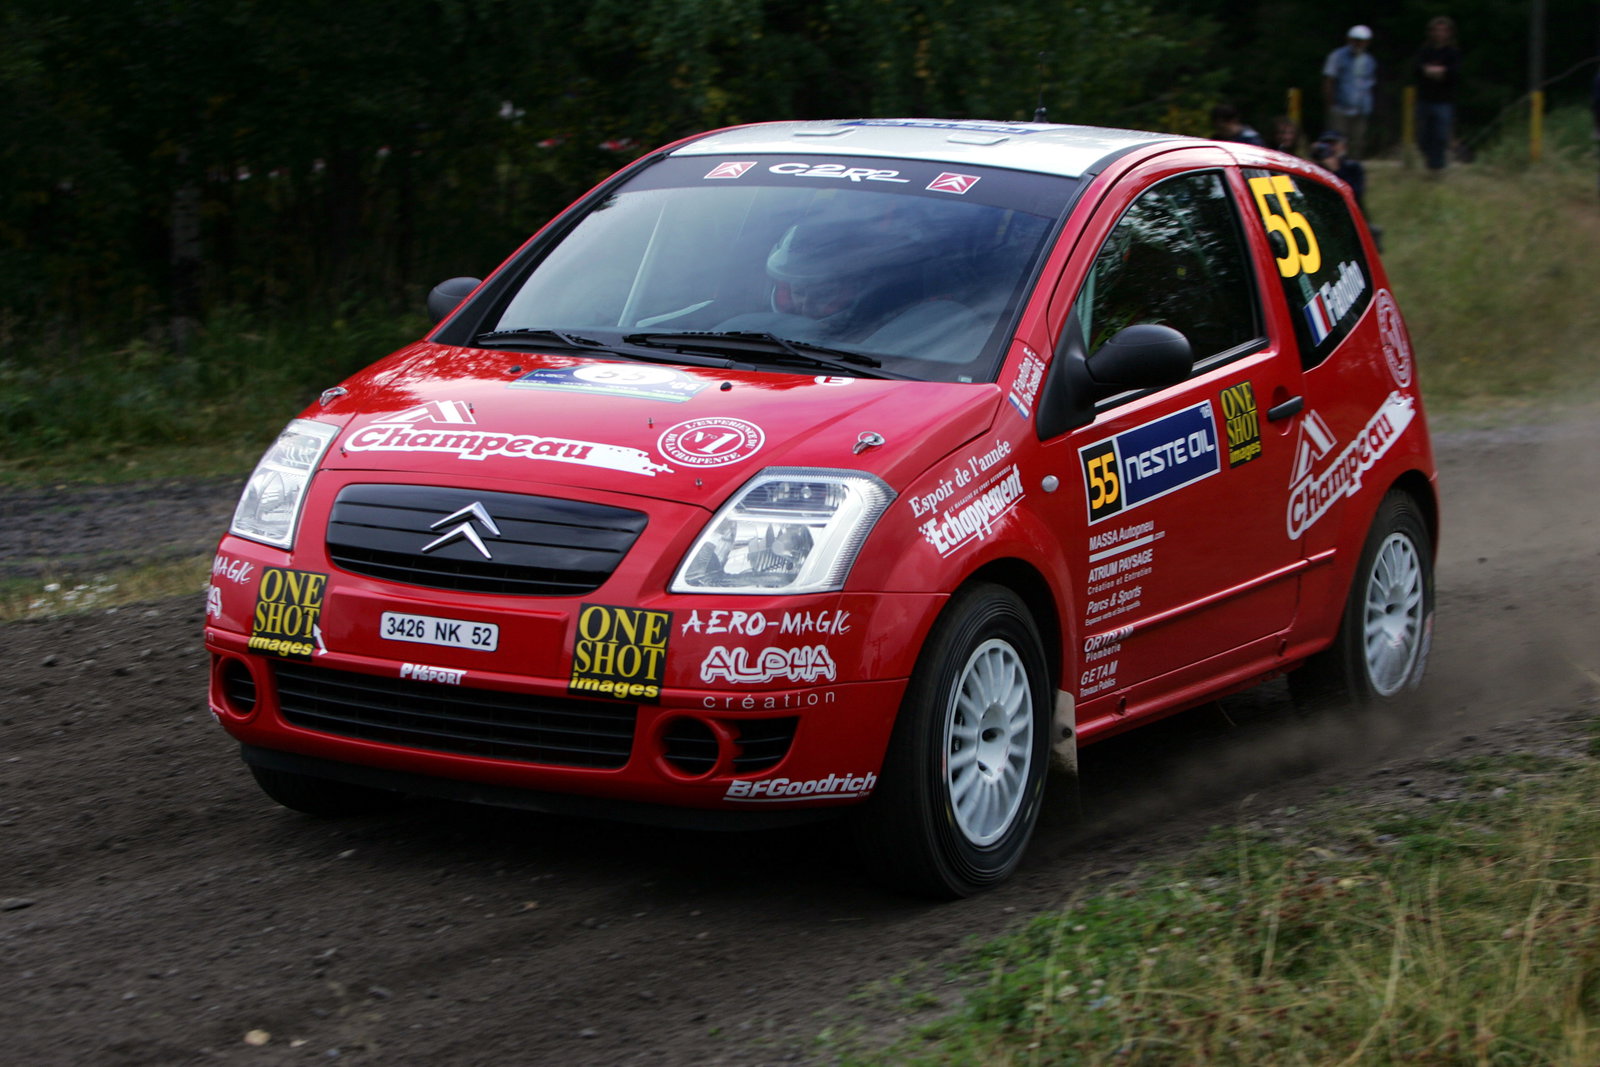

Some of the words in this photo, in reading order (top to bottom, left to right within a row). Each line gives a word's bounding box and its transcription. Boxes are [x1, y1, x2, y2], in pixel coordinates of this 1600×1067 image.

[769, 162, 911, 183] C2R2
[1248, 175, 1322, 278] 55
[1220, 381, 1256, 420] ONE
[351, 426, 594, 457] Champeau
[1226, 409, 1260, 448] SHOT
[1125, 437, 1188, 484] NESTE
[1188, 429, 1214, 459] OIL
[1229, 441, 1261, 464] images
[908, 478, 955, 518] Espoir
[955, 467, 972, 488] de
[968, 440, 1012, 478] l'année
[1087, 451, 1120, 509] 55
[1291, 413, 1395, 536] Champeau
[925, 463, 1024, 554] Echappement
[1089, 529, 1118, 551] MASSA
[1087, 561, 1118, 583] ATRIUM
[1119, 548, 1153, 572] PAYSAGE
[1116, 574, 1123, 585] et
[259, 569, 325, 609] ONE
[1086, 598, 1109, 615] Parcs
[1118, 585, 1142, 605] Sports
[253, 601, 320, 638] SHOT
[386, 616, 425, 639] 3426
[435, 622, 460, 643] NK
[472, 626, 492, 647] 52
[579, 605, 669, 648] ONE
[681, 609, 852, 637] AERO-MAGIC
[248, 632, 313, 656] images
[573, 640, 665, 681] SHOT
[700, 645, 838, 683] ALPHA
[1080, 660, 1119, 686] GETAM
[569, 674, 658, 699] images
[703, 689, 836, 709] création
[725, 771, 878, 798] BFGoodrich
